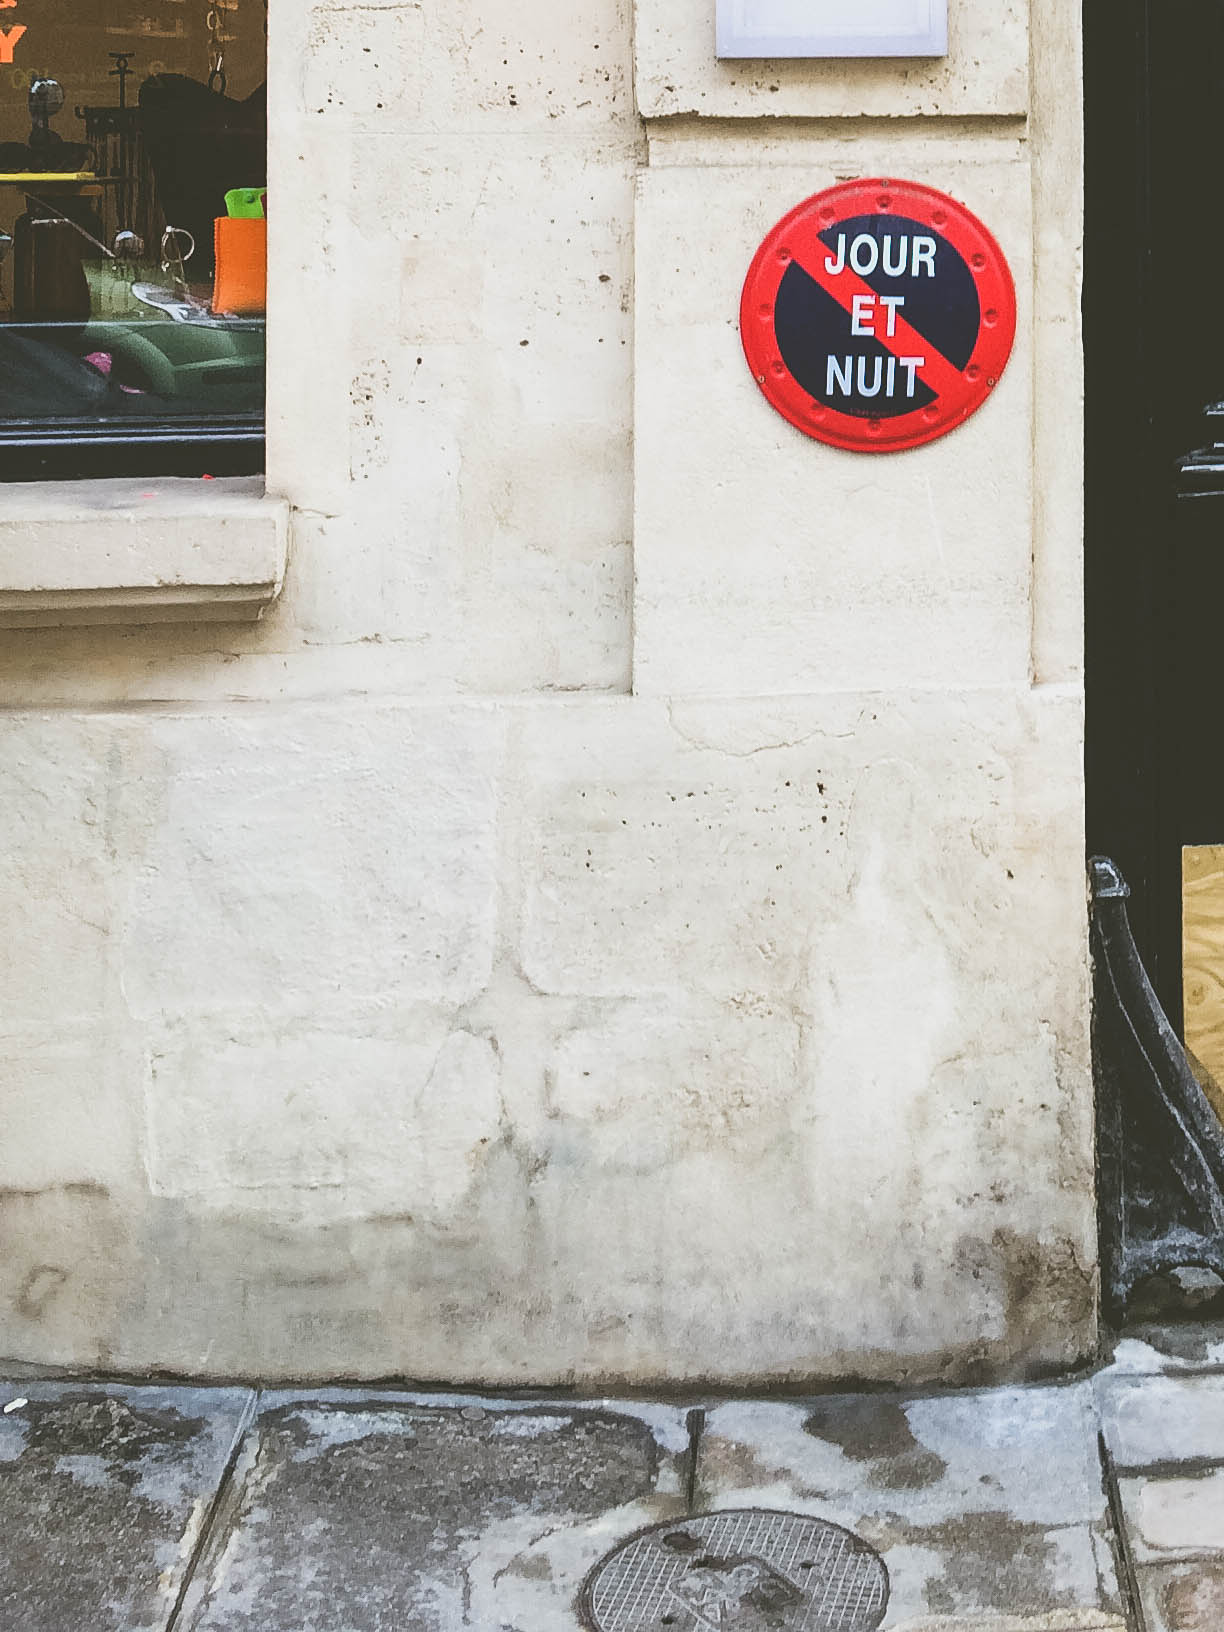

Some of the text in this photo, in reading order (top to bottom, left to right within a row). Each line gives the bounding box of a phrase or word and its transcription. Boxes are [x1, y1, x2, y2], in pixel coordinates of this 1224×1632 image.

[824, 233, 936, 277] JOUR
[851, 295, 905, 336] ET
[826, 355, 925, 398] NUIT
